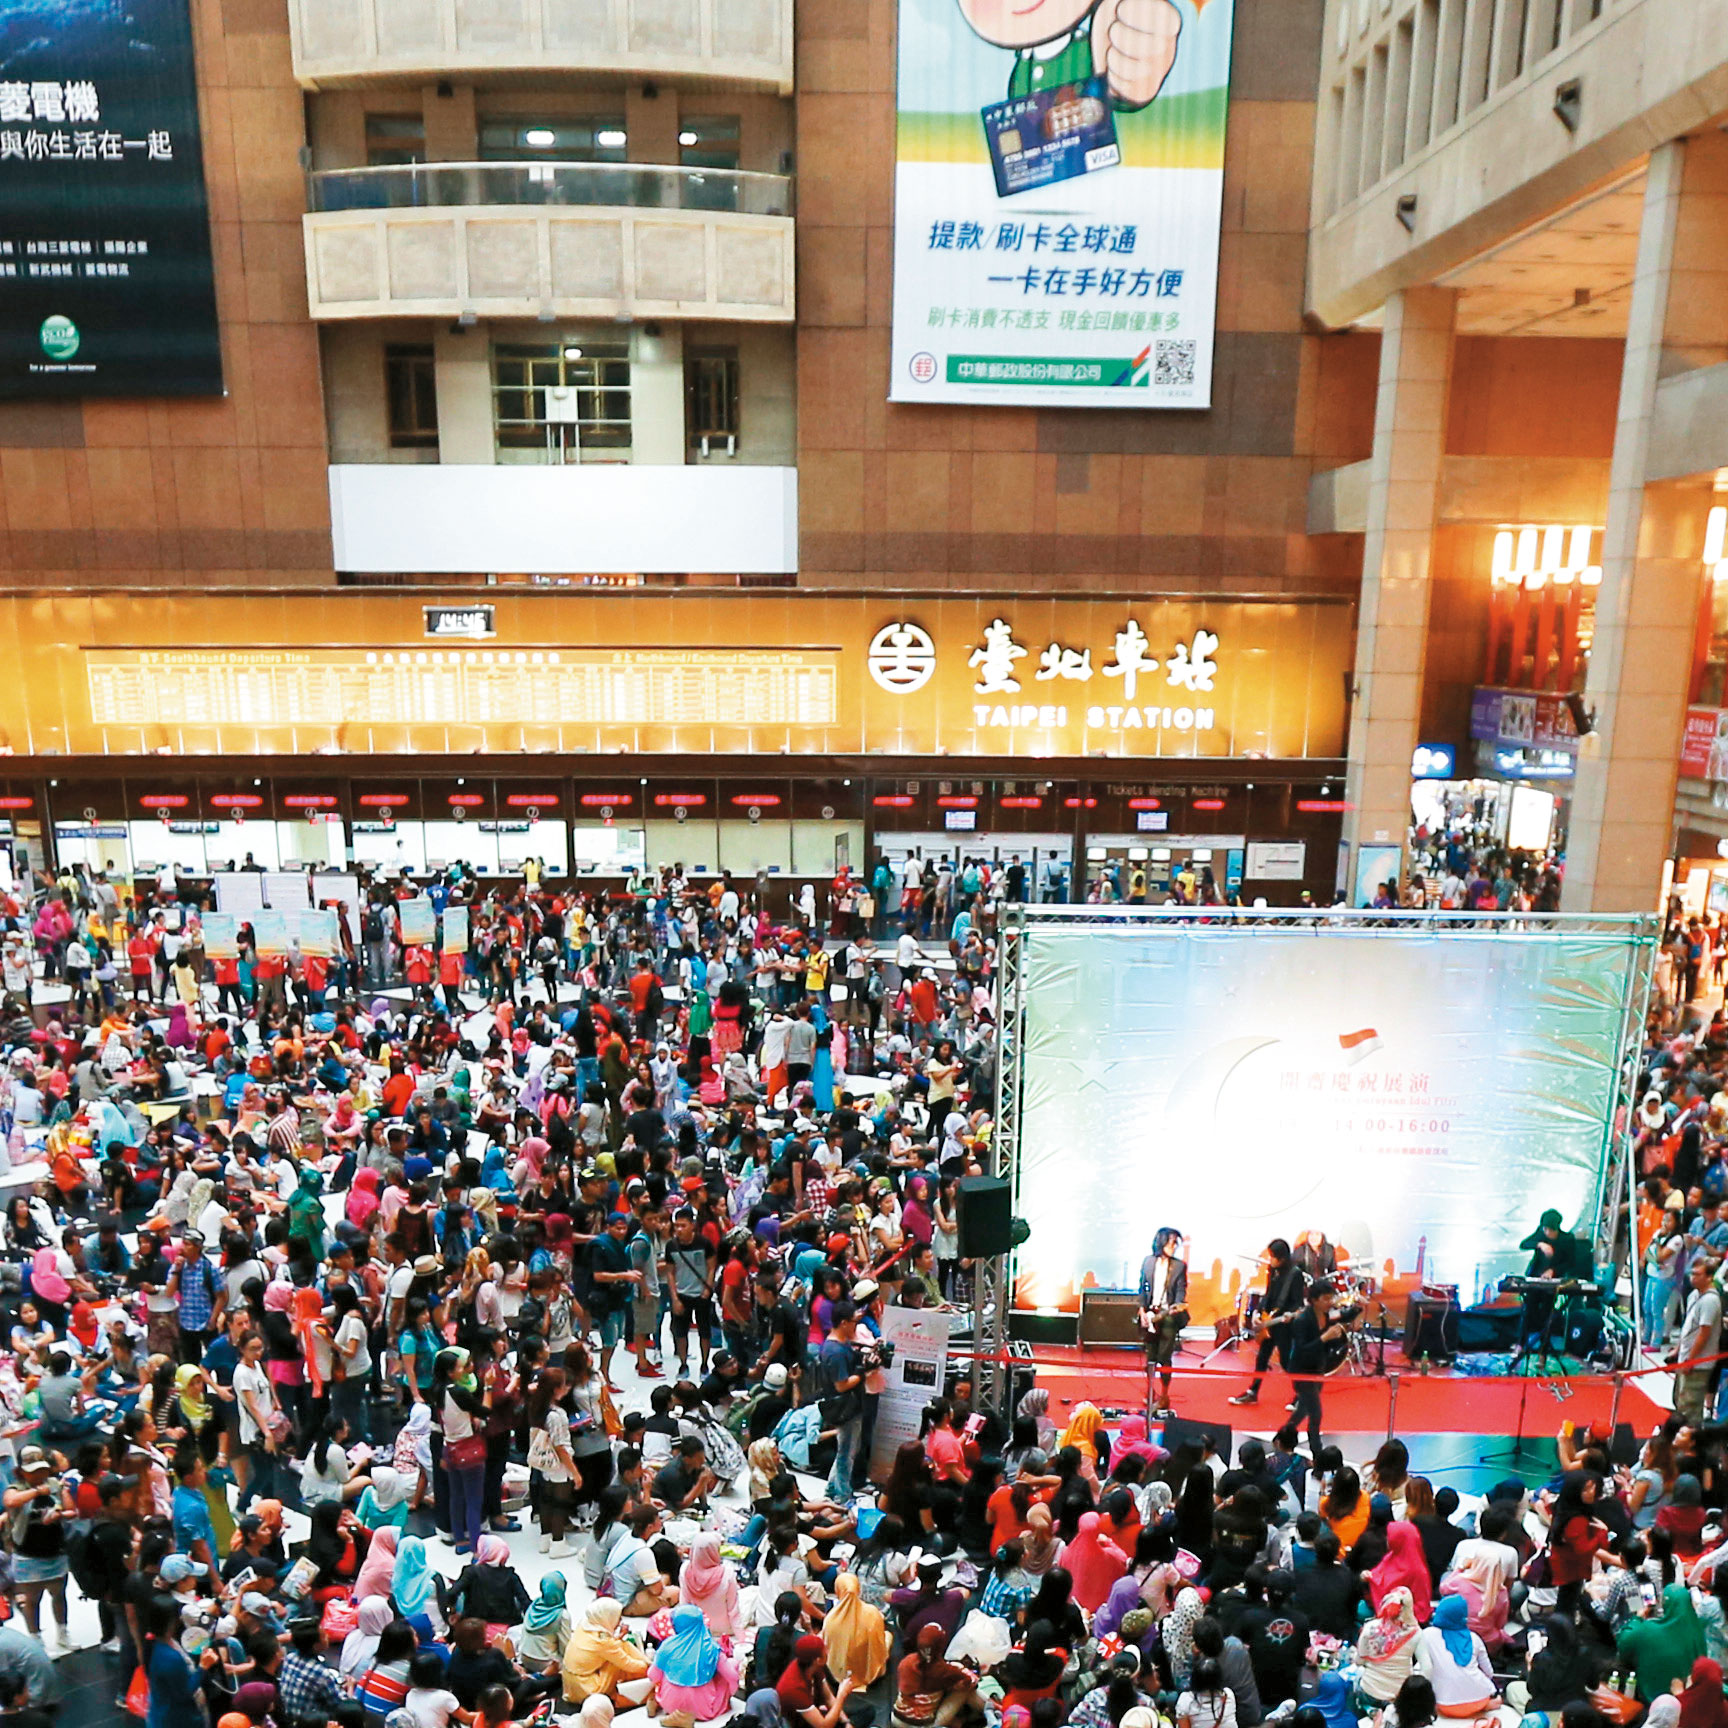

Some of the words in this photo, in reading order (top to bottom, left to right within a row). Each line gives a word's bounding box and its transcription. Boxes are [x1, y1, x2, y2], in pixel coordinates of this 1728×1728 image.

[1092, 149, 1115, 164] VISA
[987, 266, 1183, 298] 一卡在手好方便
[927, 306, 1051, 330] 刷卡消費不透支
[1058, 309, 1180, 332] 現金回饋優惠多
[957, 361, 1102, 381] 中華郵政股份有限公司
[968, 618, 1218, 700] 臺北車站
[973, 705, 1067, 727] TAIPEI
[1087, 706, 1214, 730] STATION
